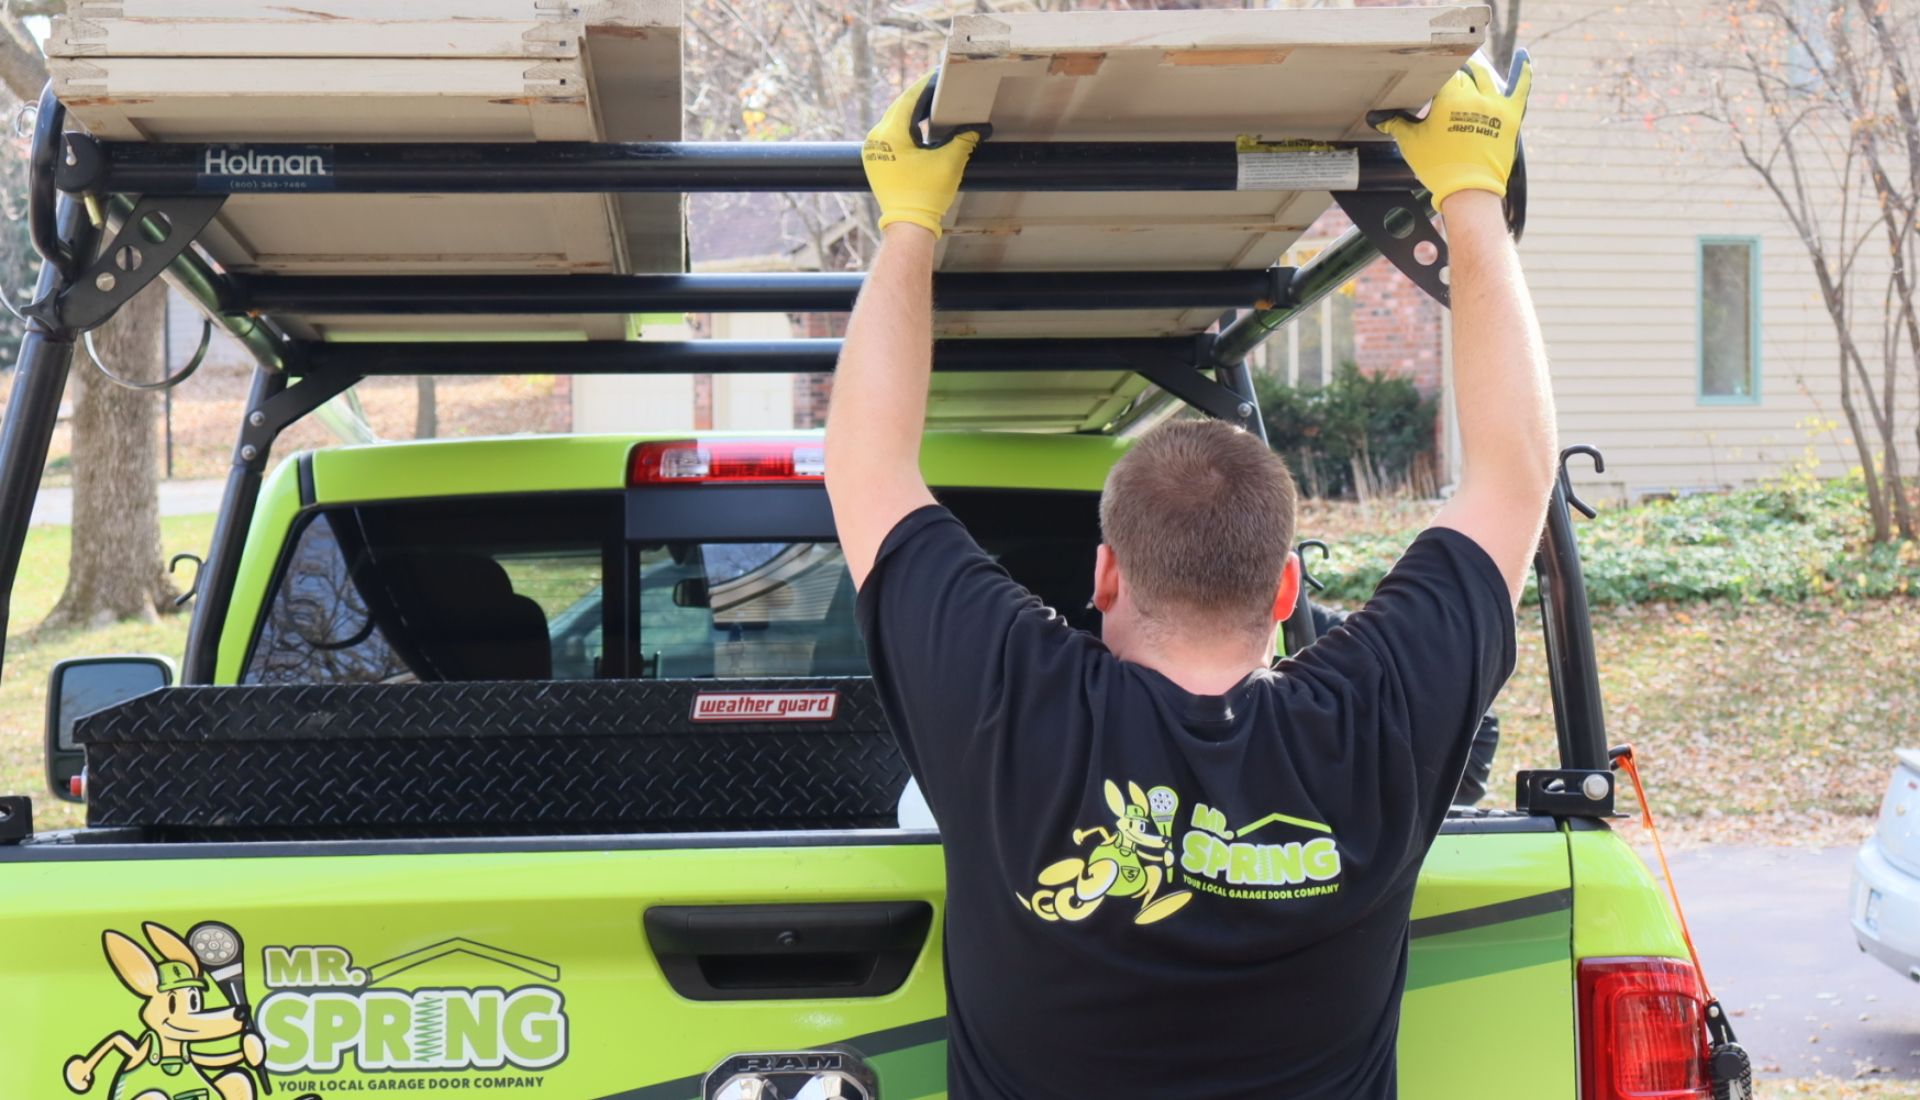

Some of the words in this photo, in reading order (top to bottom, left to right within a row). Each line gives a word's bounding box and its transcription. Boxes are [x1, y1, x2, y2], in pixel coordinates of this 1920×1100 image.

[1447, 124, 1475, 133] GRIP
[1476, 126, 1499, 139] FIRM
[205, 149, 326, 175] Holman
[700, 698, 774, 713] weather
[778, 697, 830, 715] guard
[1181, 830, 1341, 885] SPRING
[1183, 874, 1201, 890] YOUR
[1202, 883, 1227, 897] LOCAL
[1228, 889, 1266, 899] GARAGE
[1268, 889, 1292, 899] DOOR
[1294, 883, 1339, 898] COMPANY
[264, 946, 369, 986] MR.
[258, 987, 567, 1072] SPRING
[738, 1055, 842, 1072] RAM
[278, 1080, 316, 1092] YOUR
[319, 1079, 364, 1092] LOCAL
[367, 1078, 425, 1091] GARAGE
[428, 1077, 470, 1090] DOOR
[473, 1076, 544, 1090] COMPANY
